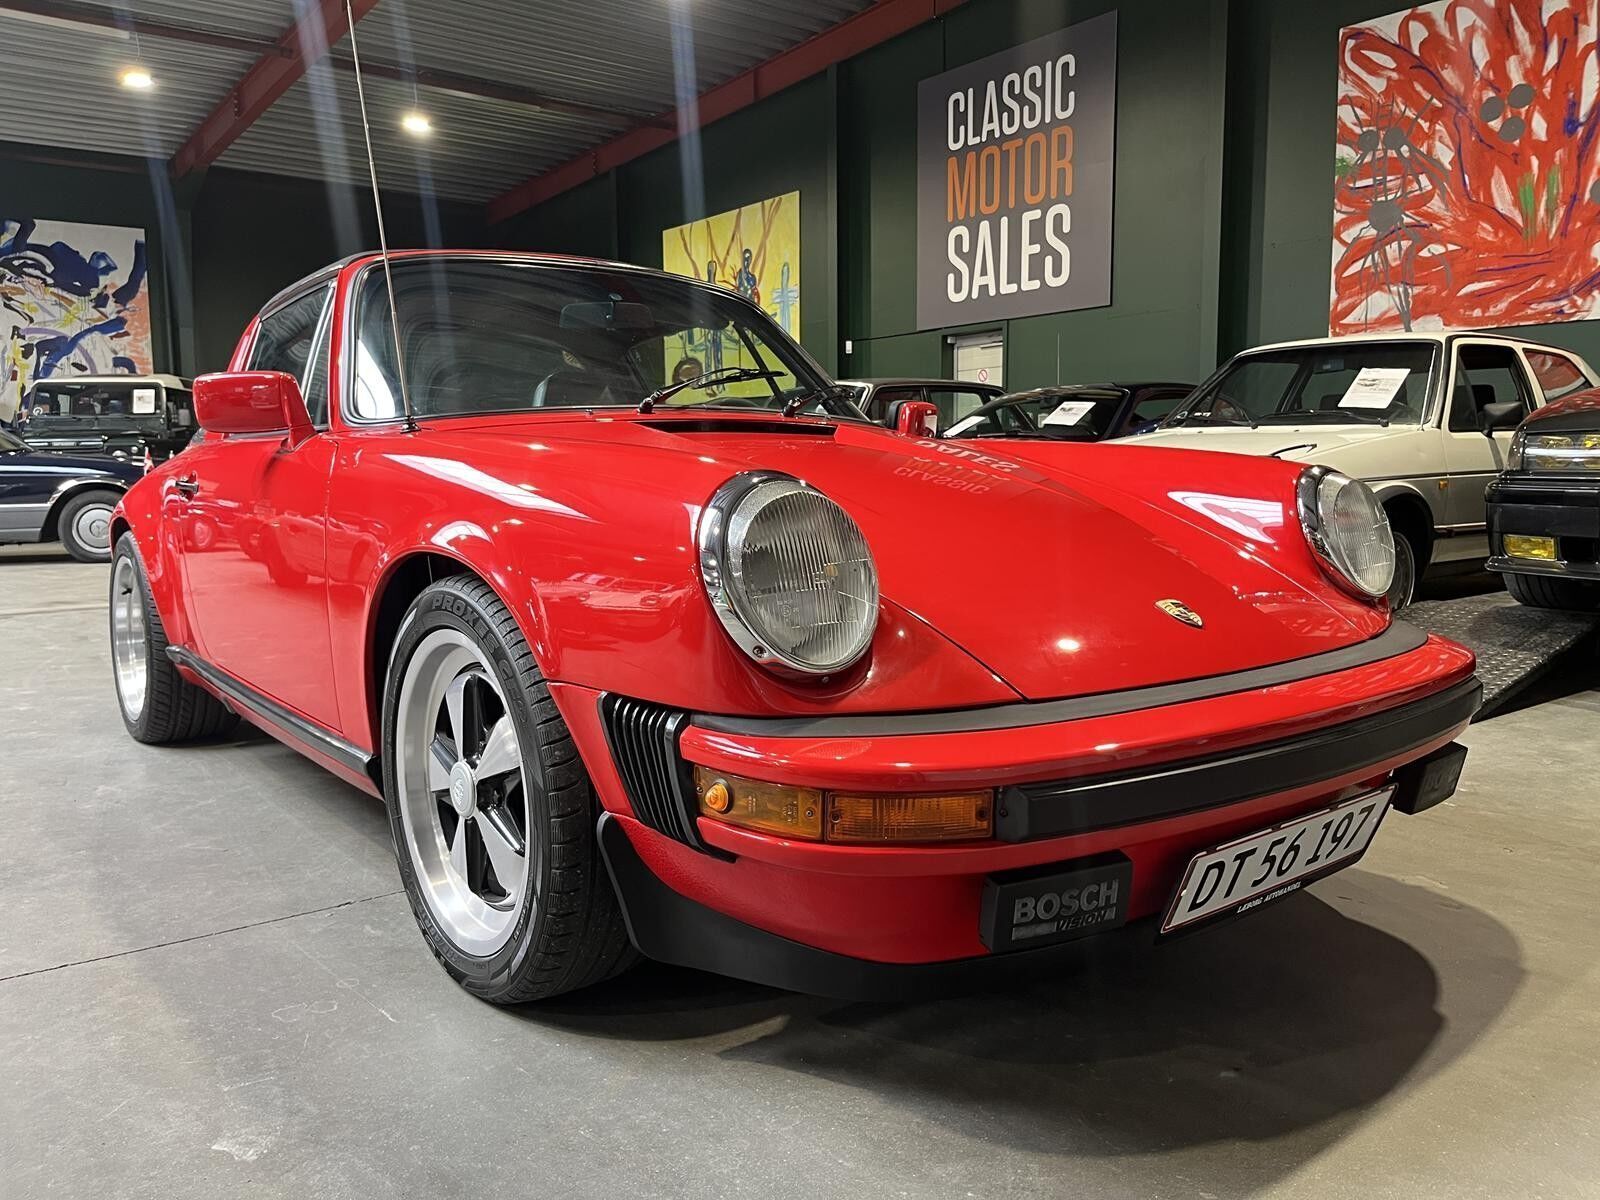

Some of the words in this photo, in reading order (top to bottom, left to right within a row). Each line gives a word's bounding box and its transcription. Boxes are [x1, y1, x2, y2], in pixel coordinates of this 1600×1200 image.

[947, 53, 1076, 151] CLASSIC
[946, 124, 1074, 223] MOTOR
[947, 203, 1071, 303] SALES
[431, 593, 500, 654] PROXES
[1012, 879, 1119, 925] BOSCH
[1187, 847, 1258, 913] DT
[1250, 827, 1306, 888] 56
[1305, 802, 1377, 867] 197
